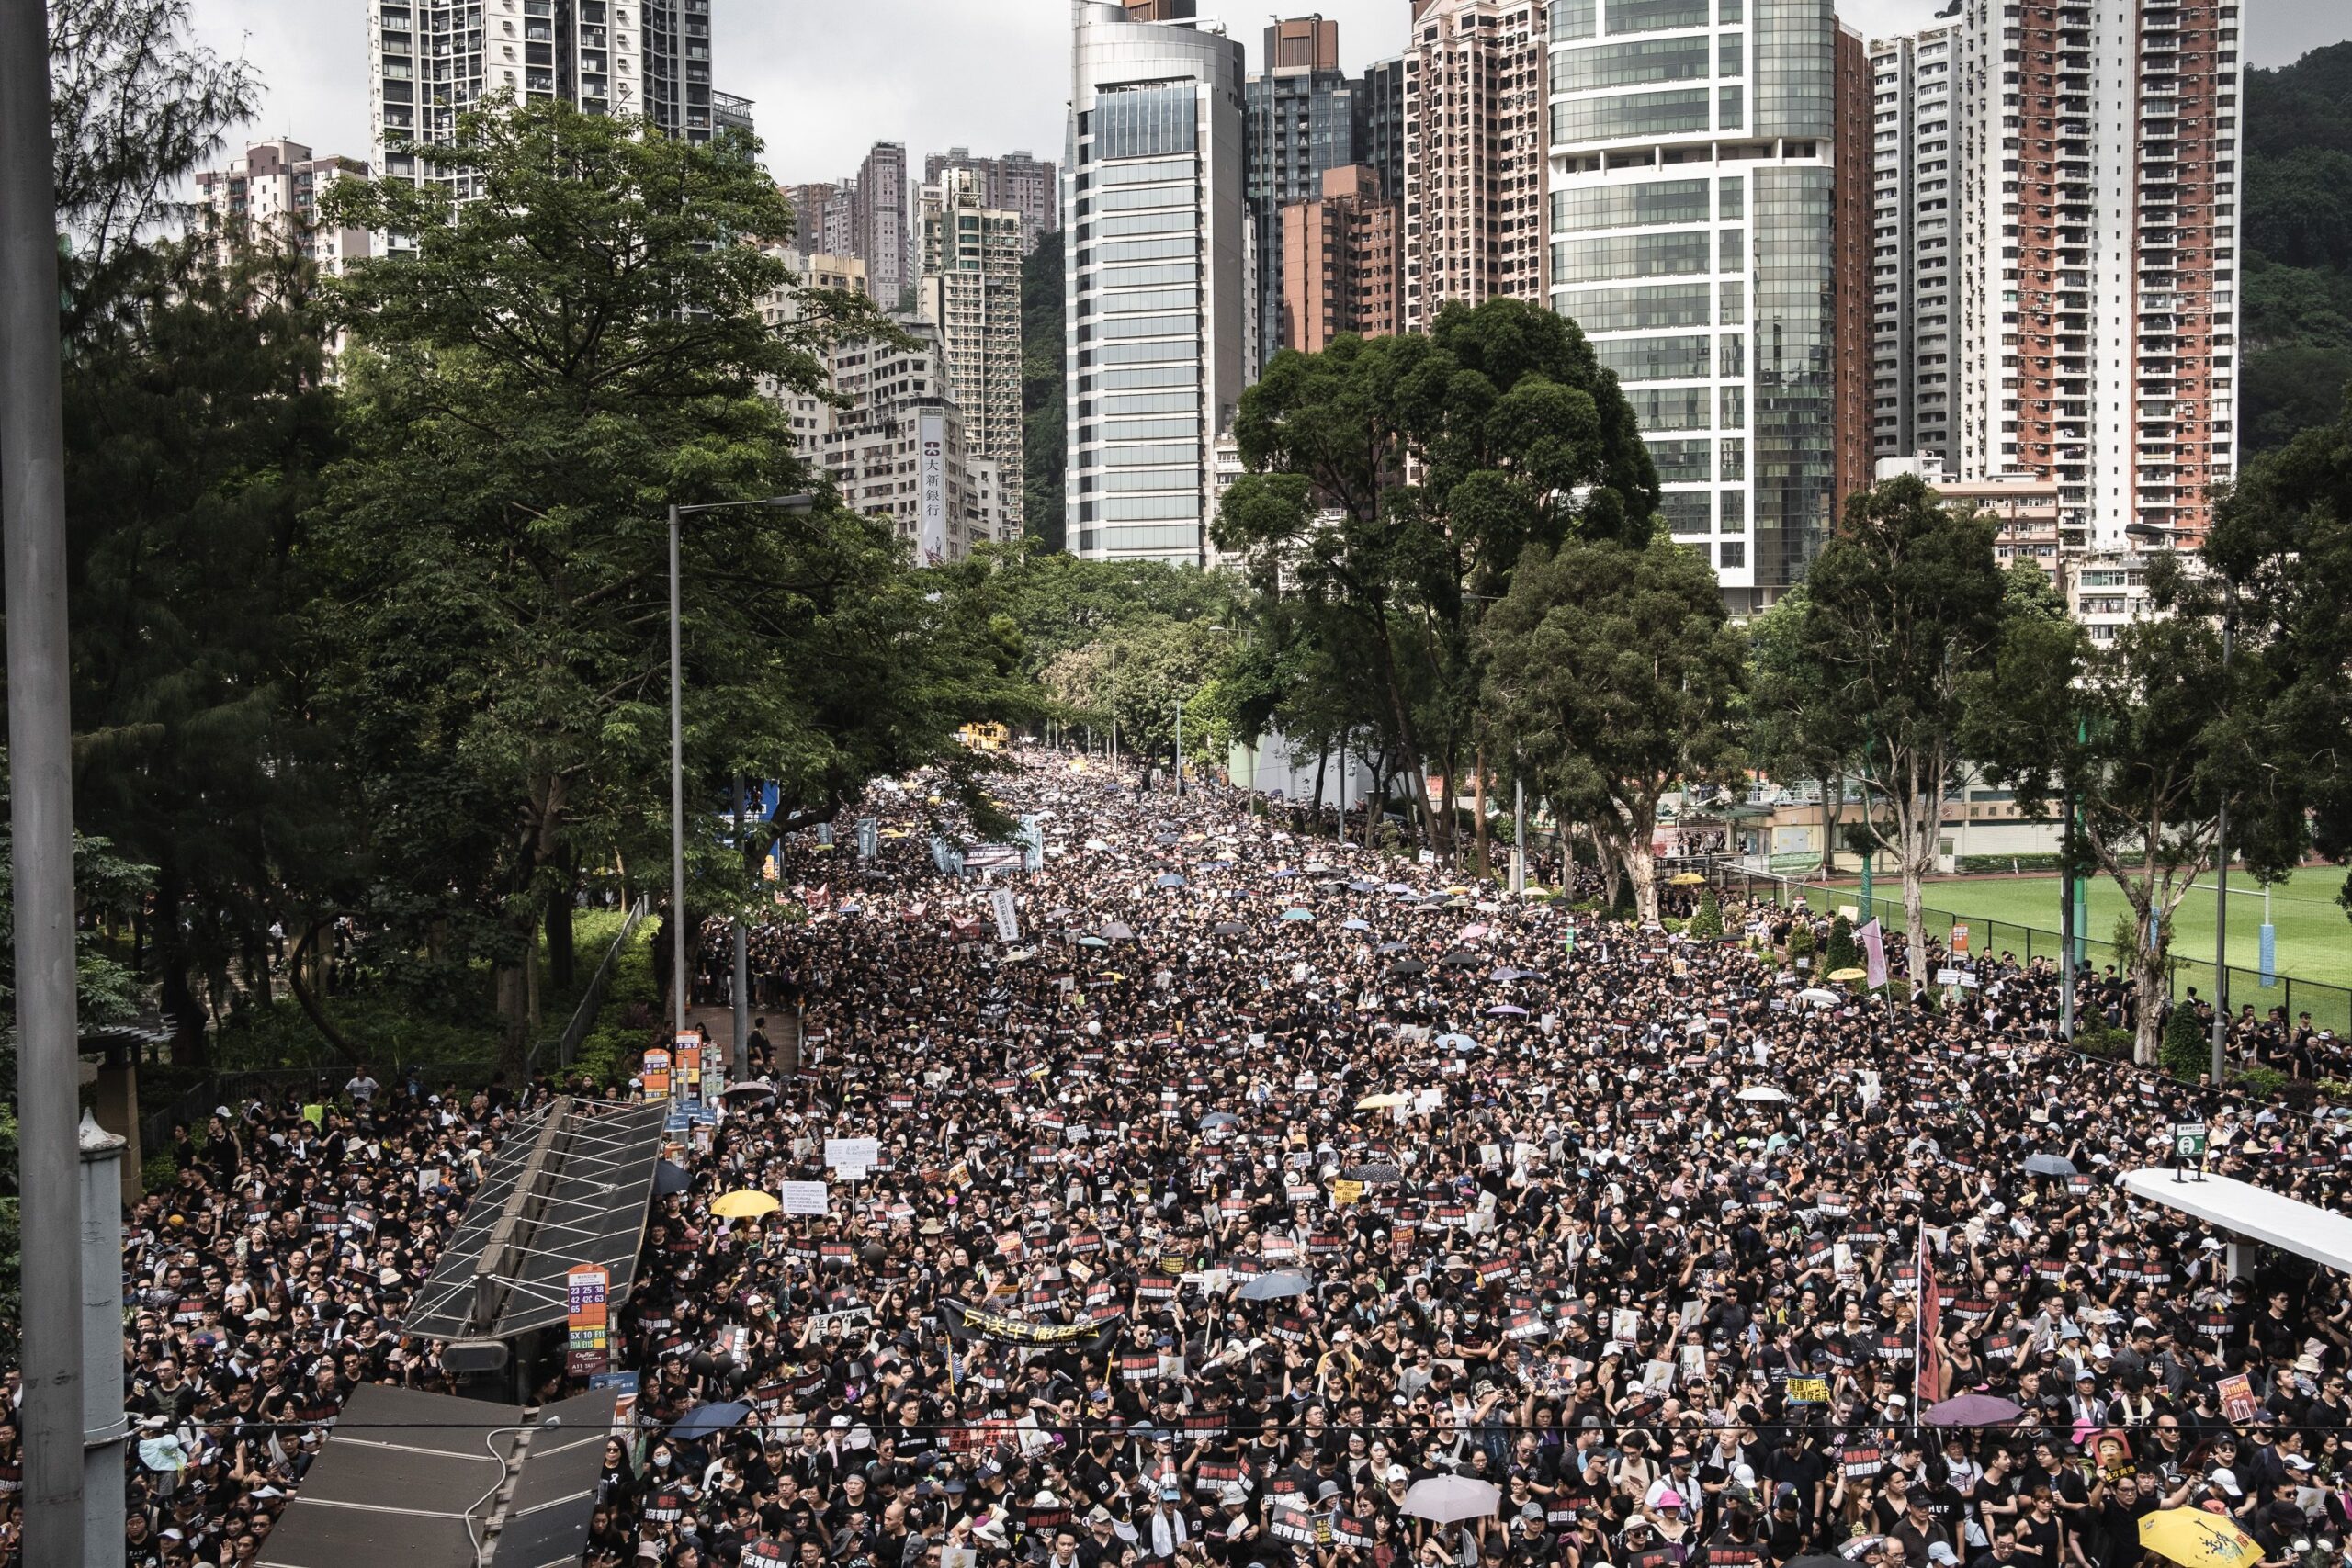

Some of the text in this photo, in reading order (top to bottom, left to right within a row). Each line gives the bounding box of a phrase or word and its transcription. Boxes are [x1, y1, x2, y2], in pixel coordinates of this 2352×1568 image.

[925, 459, 940, 516] 大新銀行
[962, 1309, 1100, 1342] 反送中 撤惡法
[982, 1332, 1077, 1348] No China Extradition
[1789, 1379, 1826, 1391] 保護下一代
[1928, 1505, 1950, 1513] HUF
[1548, 1511, 1576, 1522] 撤回控
